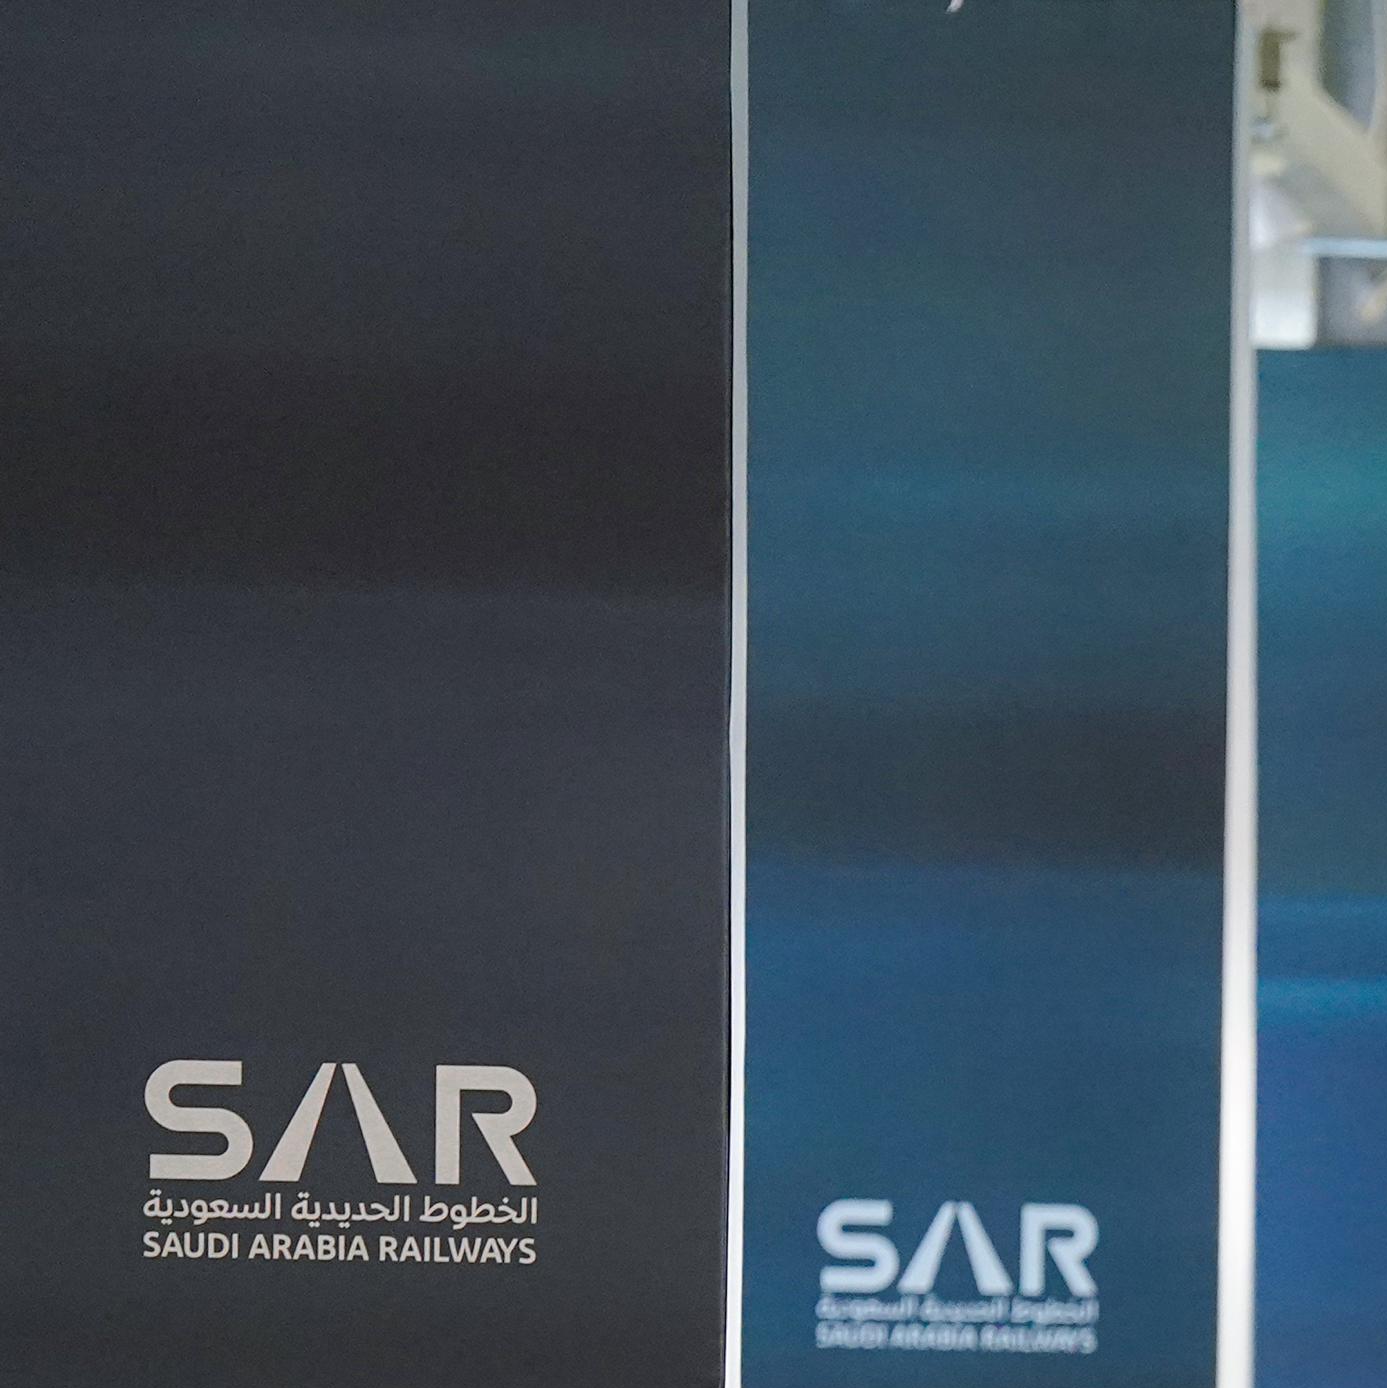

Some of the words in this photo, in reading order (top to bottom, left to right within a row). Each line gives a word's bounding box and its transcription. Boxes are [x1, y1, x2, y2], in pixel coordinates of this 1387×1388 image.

[144, 1059, 538, 1186] SAR
[142, 1189, 282, 1225] السعودية
[290, 1191, 411, 1228] الحديدية
[419, 1195, 538, 1229] الخطوط
[142, 1231, 239, 1259] SAUDI
[248, 1233, 370, 1262] ARABIA
[379, 1235, 537, 1265] RAILWAYS
[816, 1198, 1099, 1297] SAR
